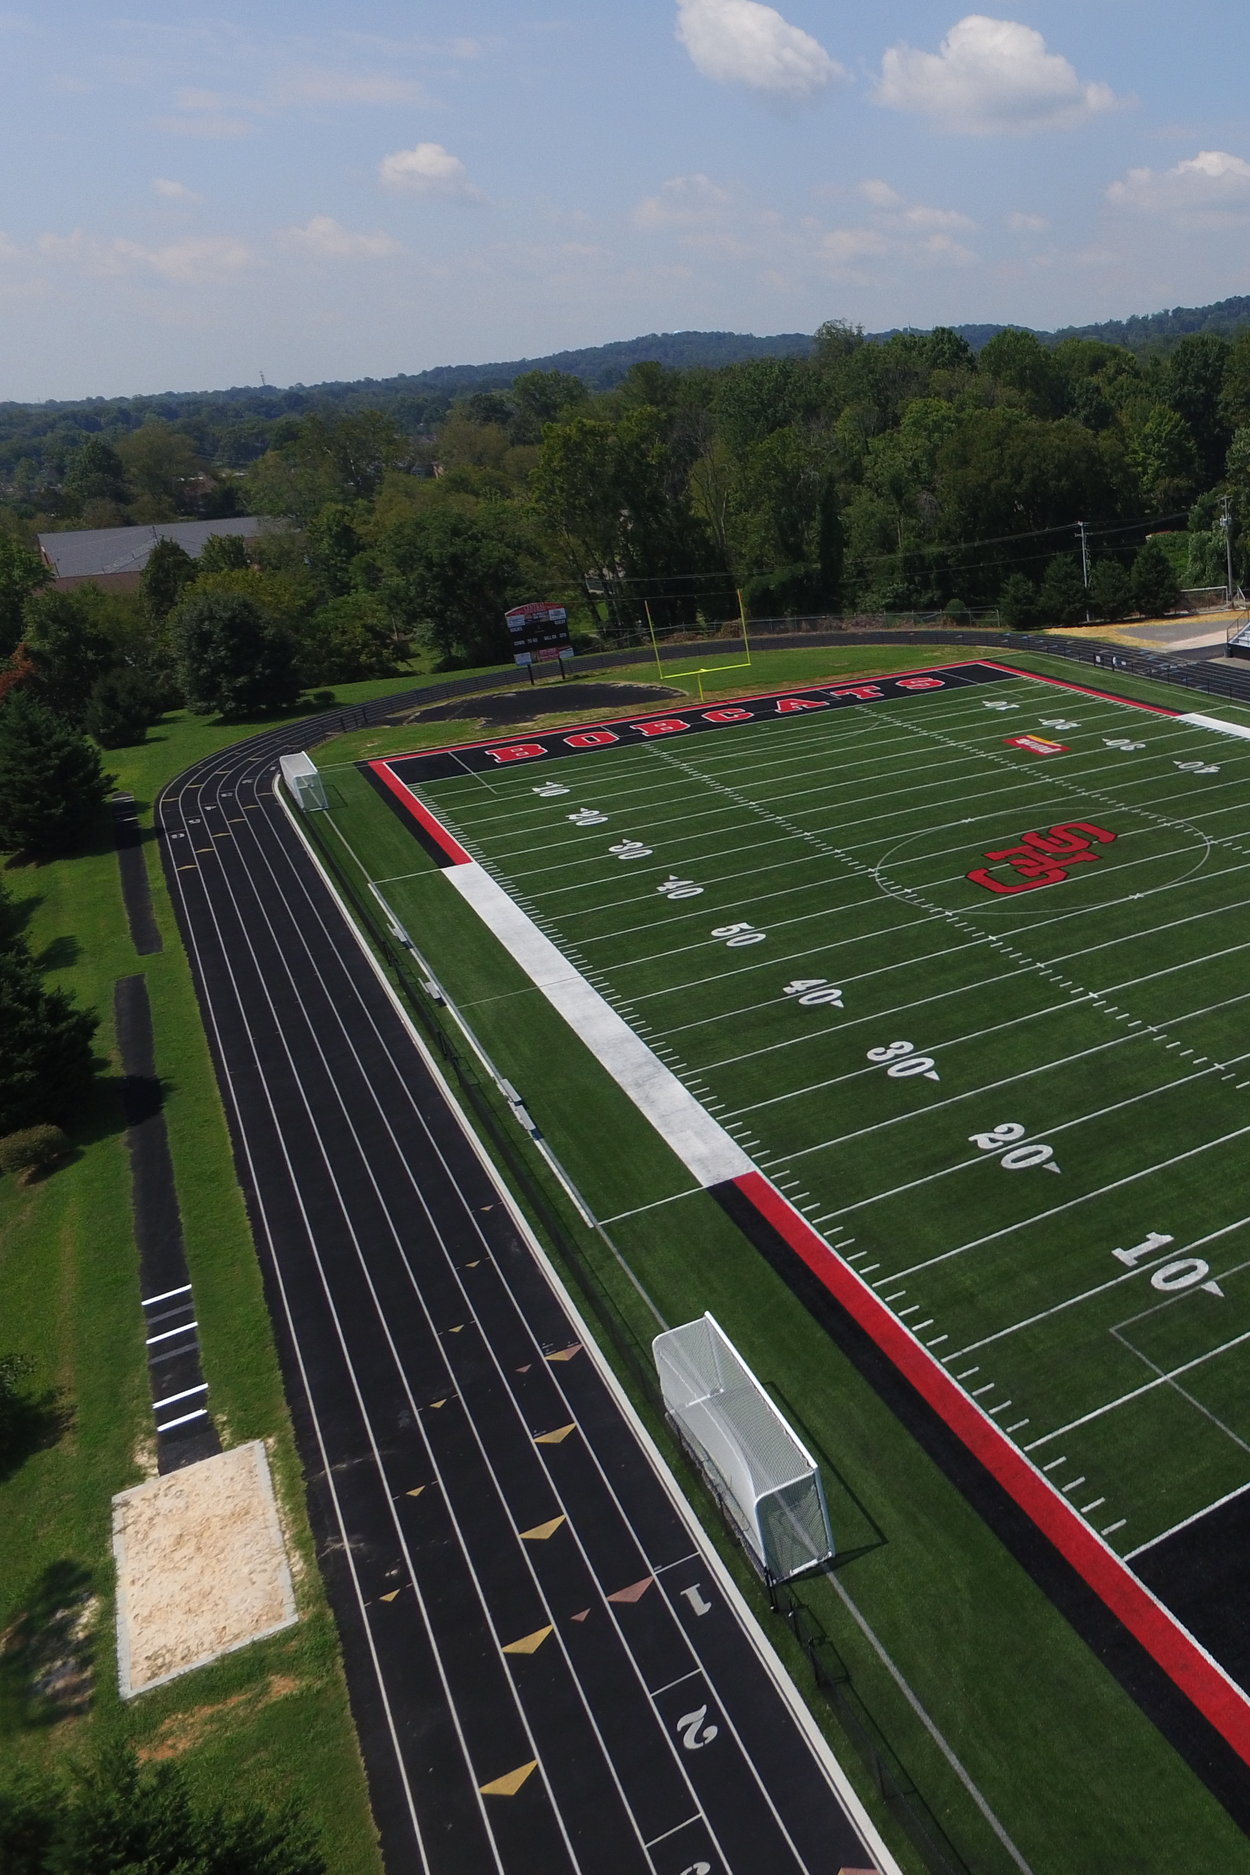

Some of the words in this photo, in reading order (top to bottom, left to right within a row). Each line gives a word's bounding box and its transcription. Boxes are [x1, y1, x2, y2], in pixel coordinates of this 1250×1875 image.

[484, 677, 946, 764] BOBCATS
[1108, 738, 1147, 751] 30
[1177, 760, 1221, 774] 40
[532, 783, 571, 797] 10
[565, 810, 609, 826] 20
[608, 841, 653, 860] 30
[656, 880, 705, 900] 40
[711, 922, 767, 947] 50
[783, 978, 842, 1006] 40
[867, 1041, 935, 1078] 30
[969, 1122, 1054, 1170] 20
[1111, 1232, 1210, 1292] 10
[680, 1583, 712, 1616] 1
[676, 1703, 719, 1750] 2
